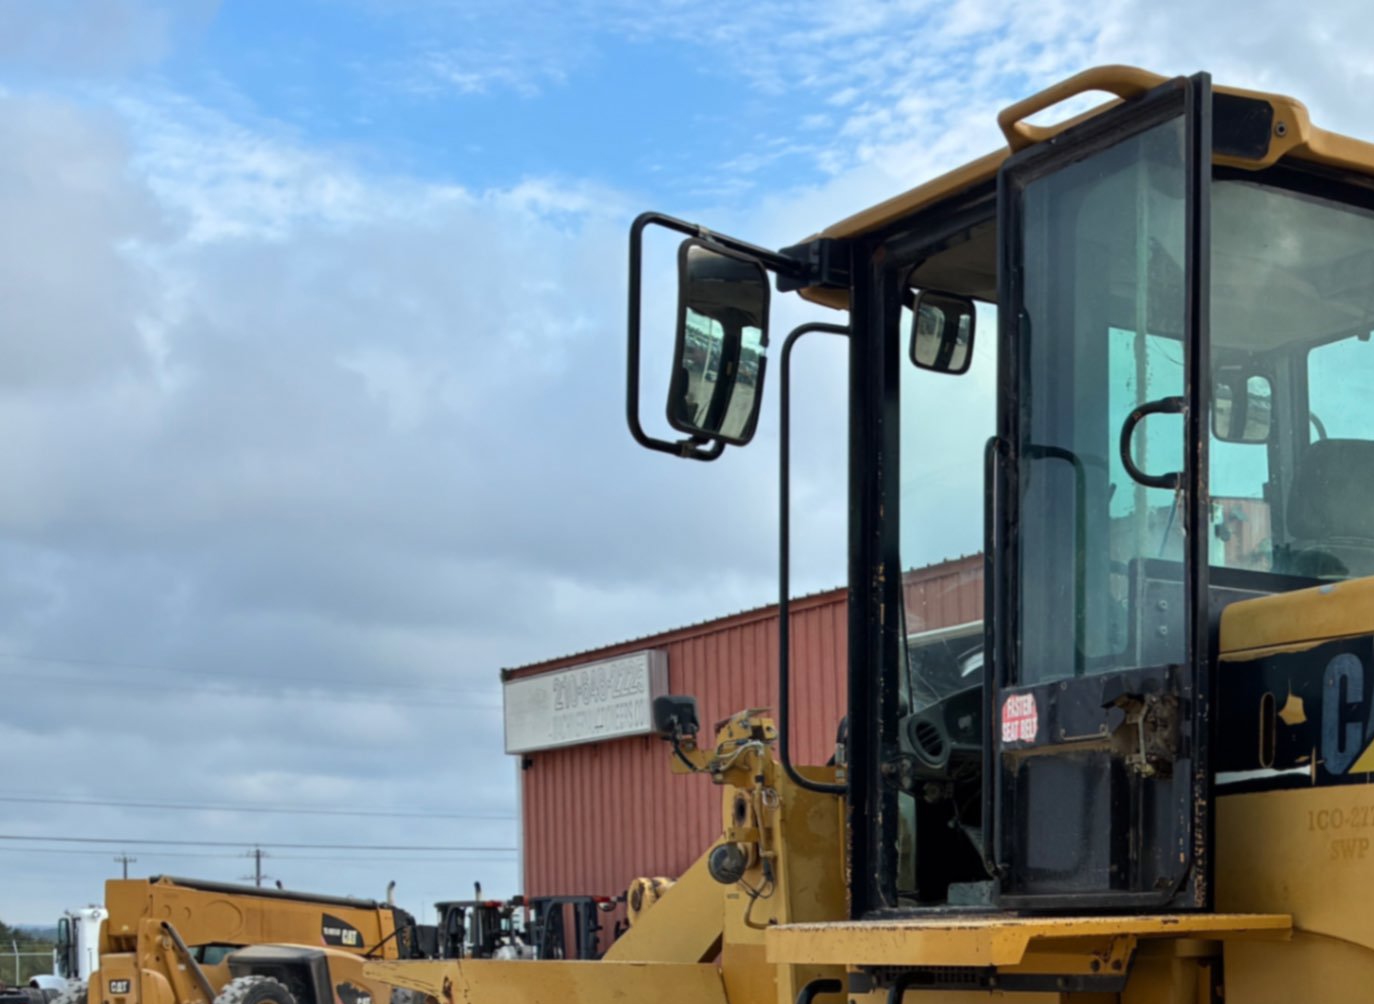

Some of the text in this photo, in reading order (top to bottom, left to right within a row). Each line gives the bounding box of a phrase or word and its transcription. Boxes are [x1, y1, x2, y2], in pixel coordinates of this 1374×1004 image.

[1002, 717, 1037, 742] SEAT BELT
[1329, 837, 1370, 861] SWP
[341, 929, 357, 945] CAT
[111, 981, 128, 993] CAT
